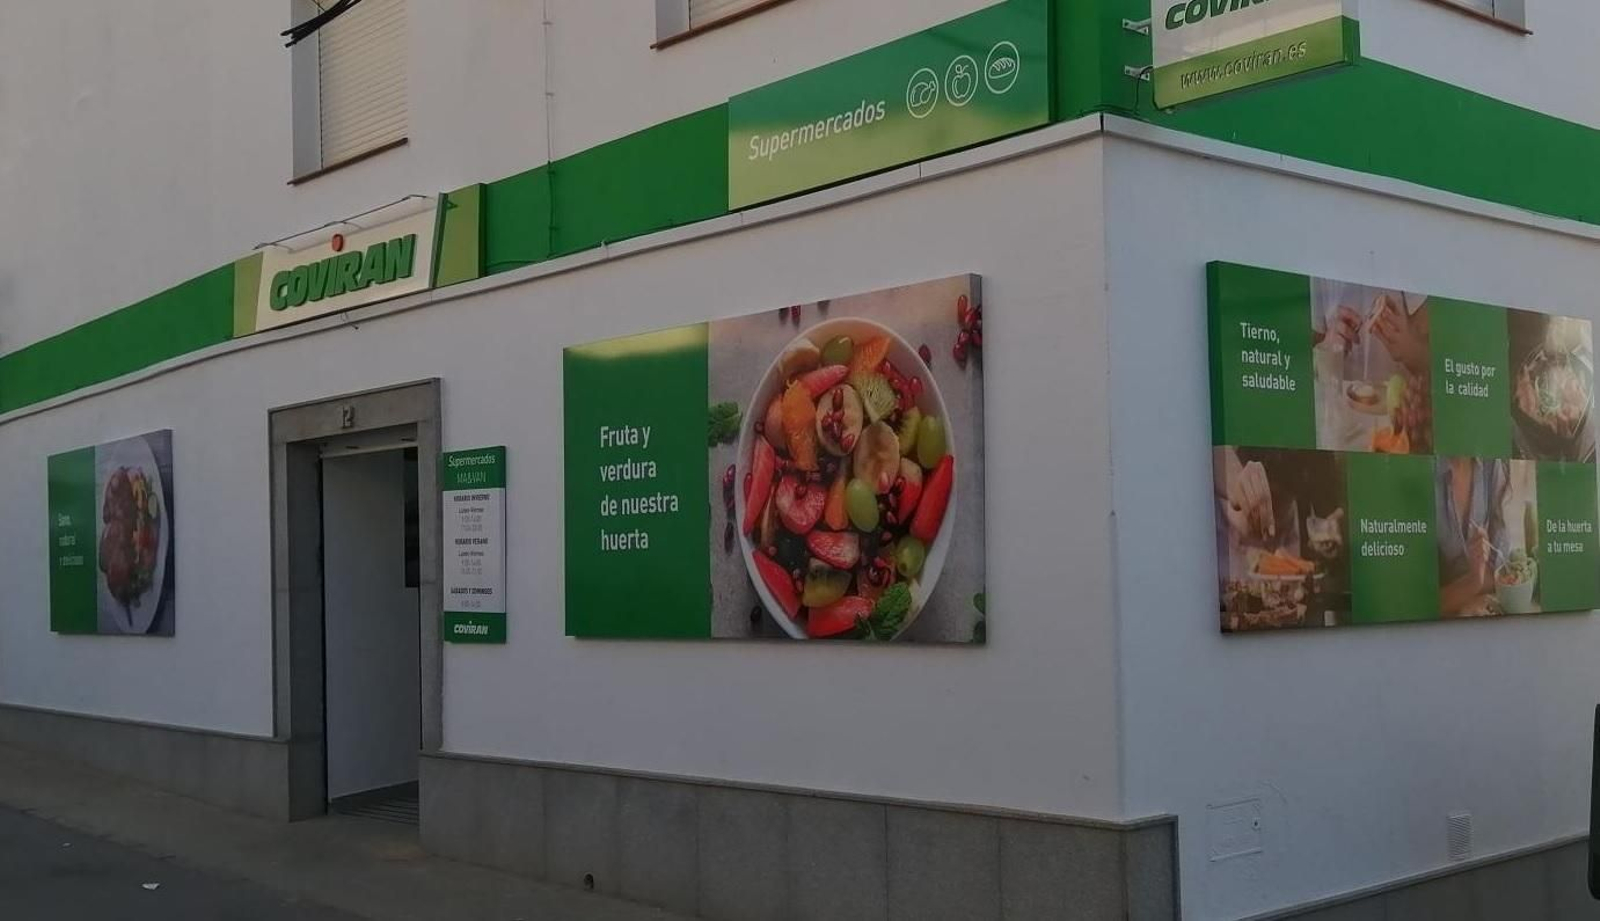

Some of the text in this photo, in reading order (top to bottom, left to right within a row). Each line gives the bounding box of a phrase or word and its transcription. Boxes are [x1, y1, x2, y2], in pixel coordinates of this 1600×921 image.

[1180, 41, 1308, 90] www.coviran.es
[748, 100, 886, 161] Supermercados
[269, 233, 417, 311] COVIRAN
[1240, 322, 1280, 344] Tierno,
[1241, 349, 1290, 370] natural y
[1445, 358, 1496, 379] El gusto por
[1242, 372, 1296, 391] saludable
[1445, 379, 1489, 397] la calidad
[600, 425, 651, 449] Fruta y
[600, 458, 657, 482] verdura
[600, 492, 679, 516] de nuestra
[1360, 519, 1428, 534] Naturalmente
[1546, 519, 1593, 533] De la huerta
[601, 529, 649, 550] huerta
[1361, 541, 1405, 557] delicioso
[1547, 542, 1552, 553] a
[1563, 542, 1584, 553] mesa
[453, 620, 489, 636] COVIRAN
